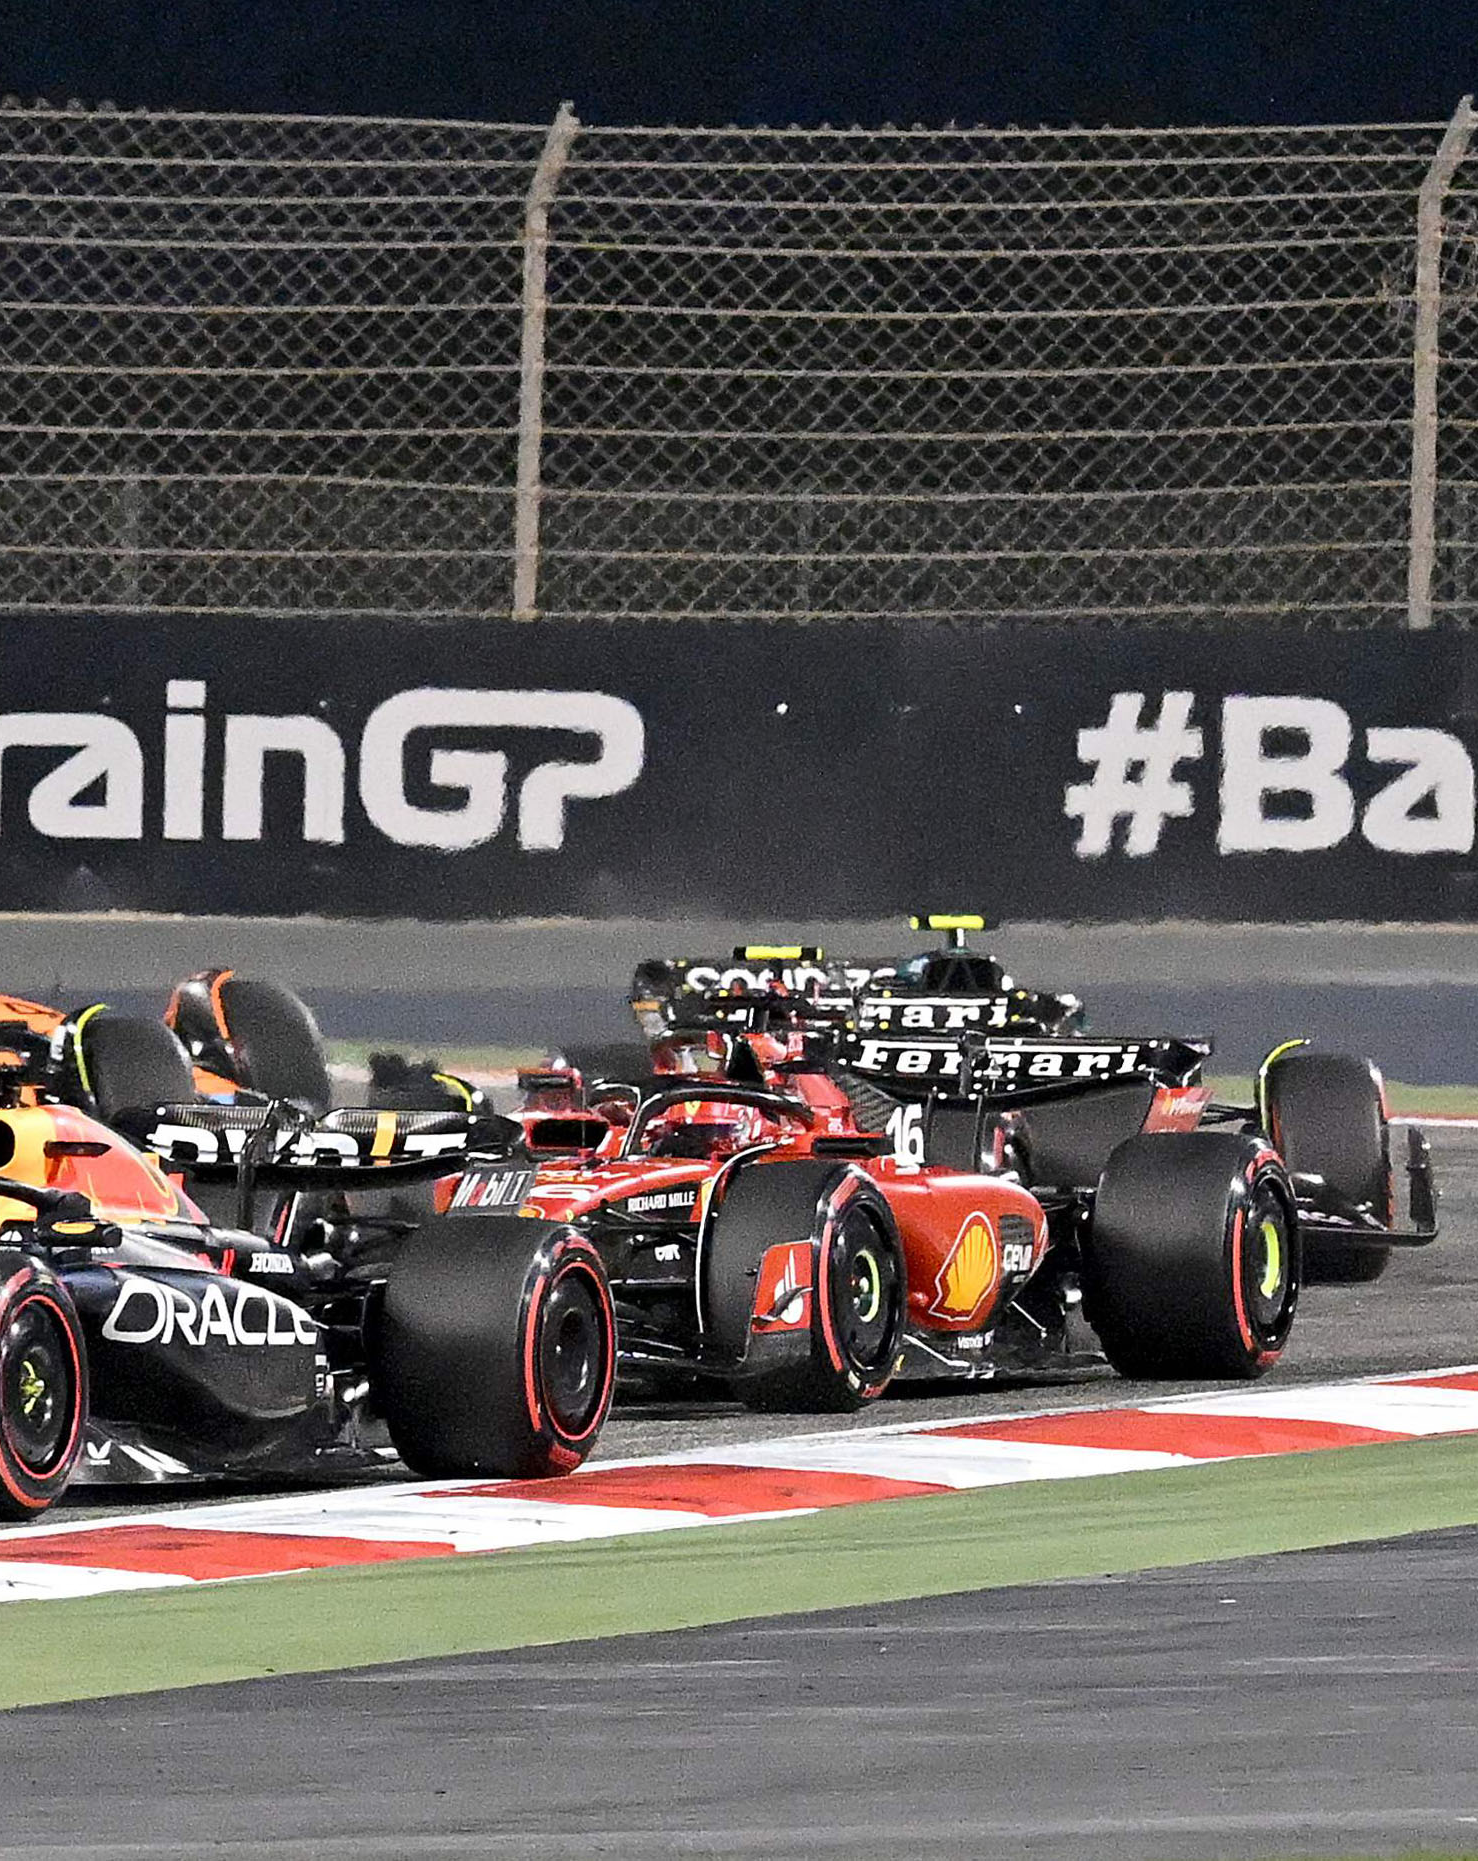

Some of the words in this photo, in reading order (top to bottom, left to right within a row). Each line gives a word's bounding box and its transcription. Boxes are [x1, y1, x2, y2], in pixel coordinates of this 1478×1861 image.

[1064, 690, 1477, 859] #Ba
[885, 1103, 925, 1168] 16
[451, 1171, 514, 1209] Mobil
[627, 1194, 667, 1213] RICHARD
[668, 1190, 696, 1208] MILLE
[249, 1253, 295, 1274] HONDA
[100, 1278, 319, 1346] ORACLE
